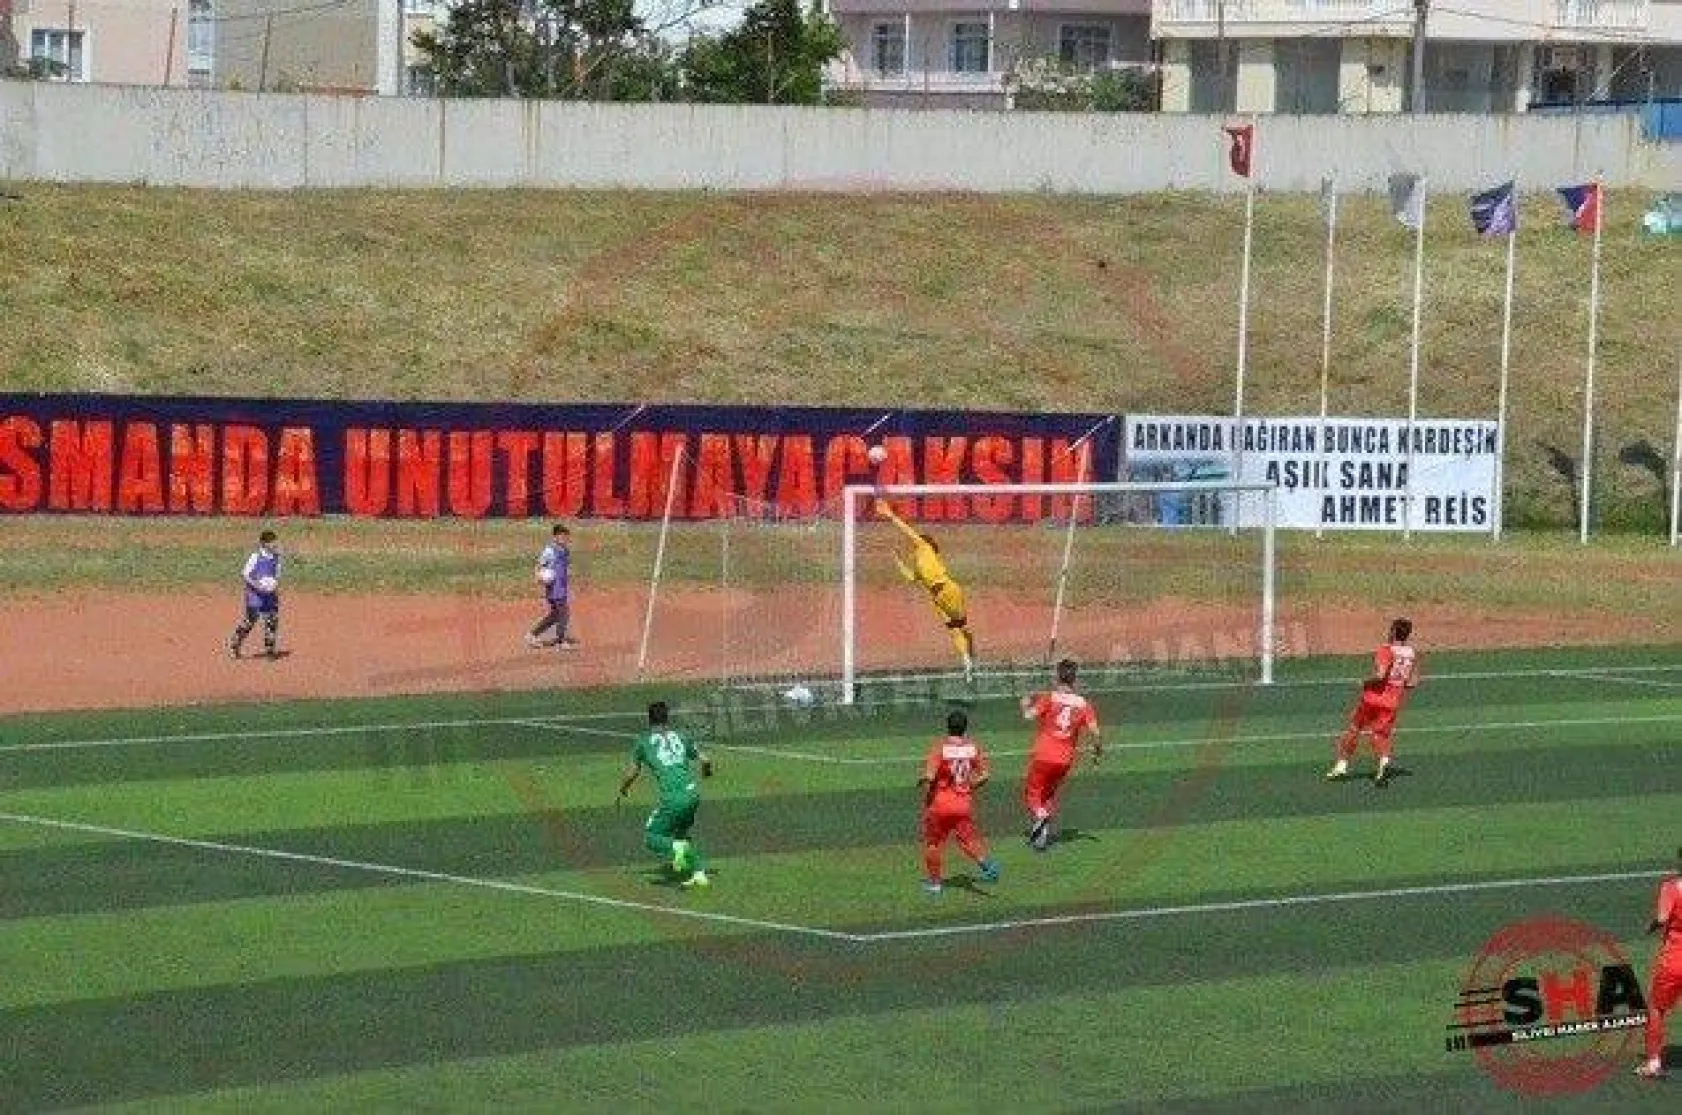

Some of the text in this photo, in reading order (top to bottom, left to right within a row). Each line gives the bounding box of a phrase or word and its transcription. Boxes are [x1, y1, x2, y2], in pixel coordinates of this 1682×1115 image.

[1133, 423, 1222, 450] ARKANDA
[1323, 425, 1389, 453] BUNCA
[1340, 461, 1407, 490] SANA
[1424, 491, 1487, 525] REİS
